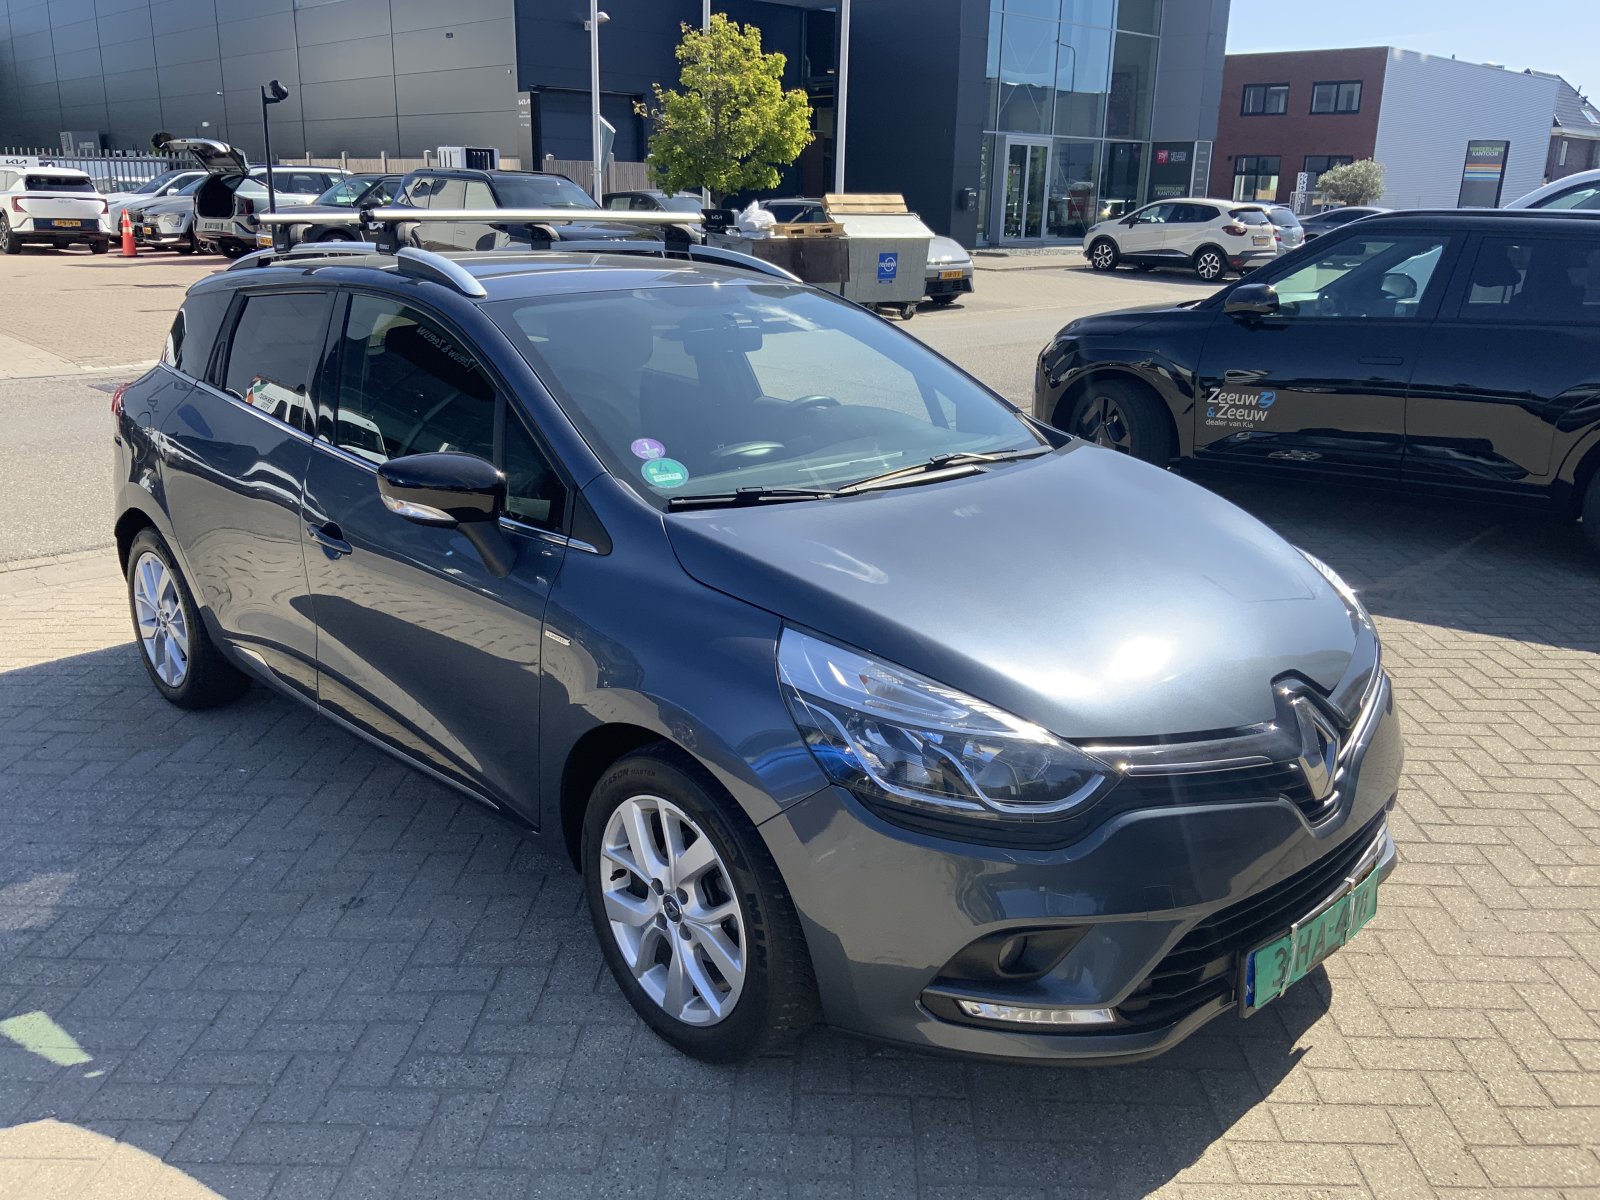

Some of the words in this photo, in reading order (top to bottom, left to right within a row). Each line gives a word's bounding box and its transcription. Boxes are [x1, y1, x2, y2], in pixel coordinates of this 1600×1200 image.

[1206, 388, 1259, 406] Zeeuw
[1216, 403, 1268, 422] Zeeuw
[1205, 418, 1227, 427] dealer
